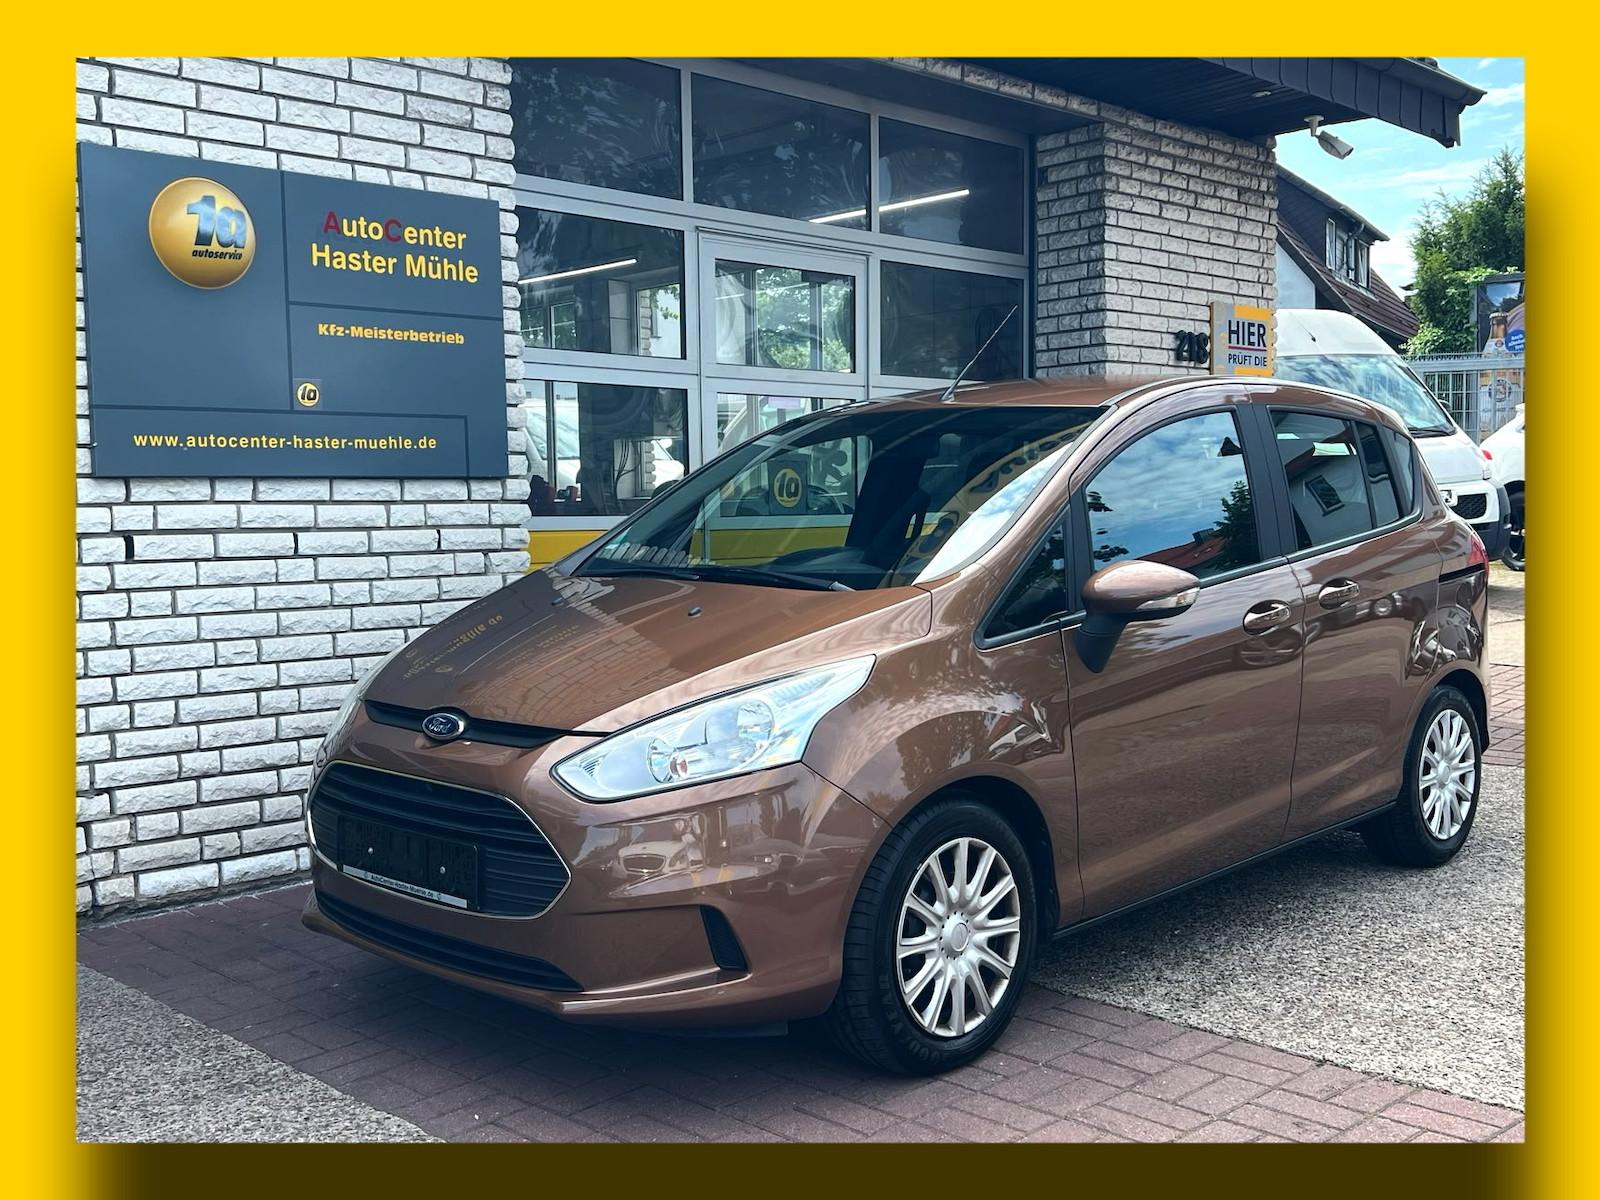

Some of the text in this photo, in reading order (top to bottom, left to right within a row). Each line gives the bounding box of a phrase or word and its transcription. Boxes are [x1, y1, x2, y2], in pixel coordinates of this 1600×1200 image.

[187, 195, 246, 249] 1a
[323, 211, 467, 250] AutoCenter
[192, 249, 243, 261] autoservice
[311, 243, 479, 283] Haster Mühle
[318, 323, 465, 345] Kfz-Meisterbetrieb
[1228, 319, 1267, 348] HIER
[1228, 352, 1268, 367] PRÜFT DIE
[133, 432, 437, 450] www.autocenter-haster-muehle.de
[428, 717, 452, 733] Ford
